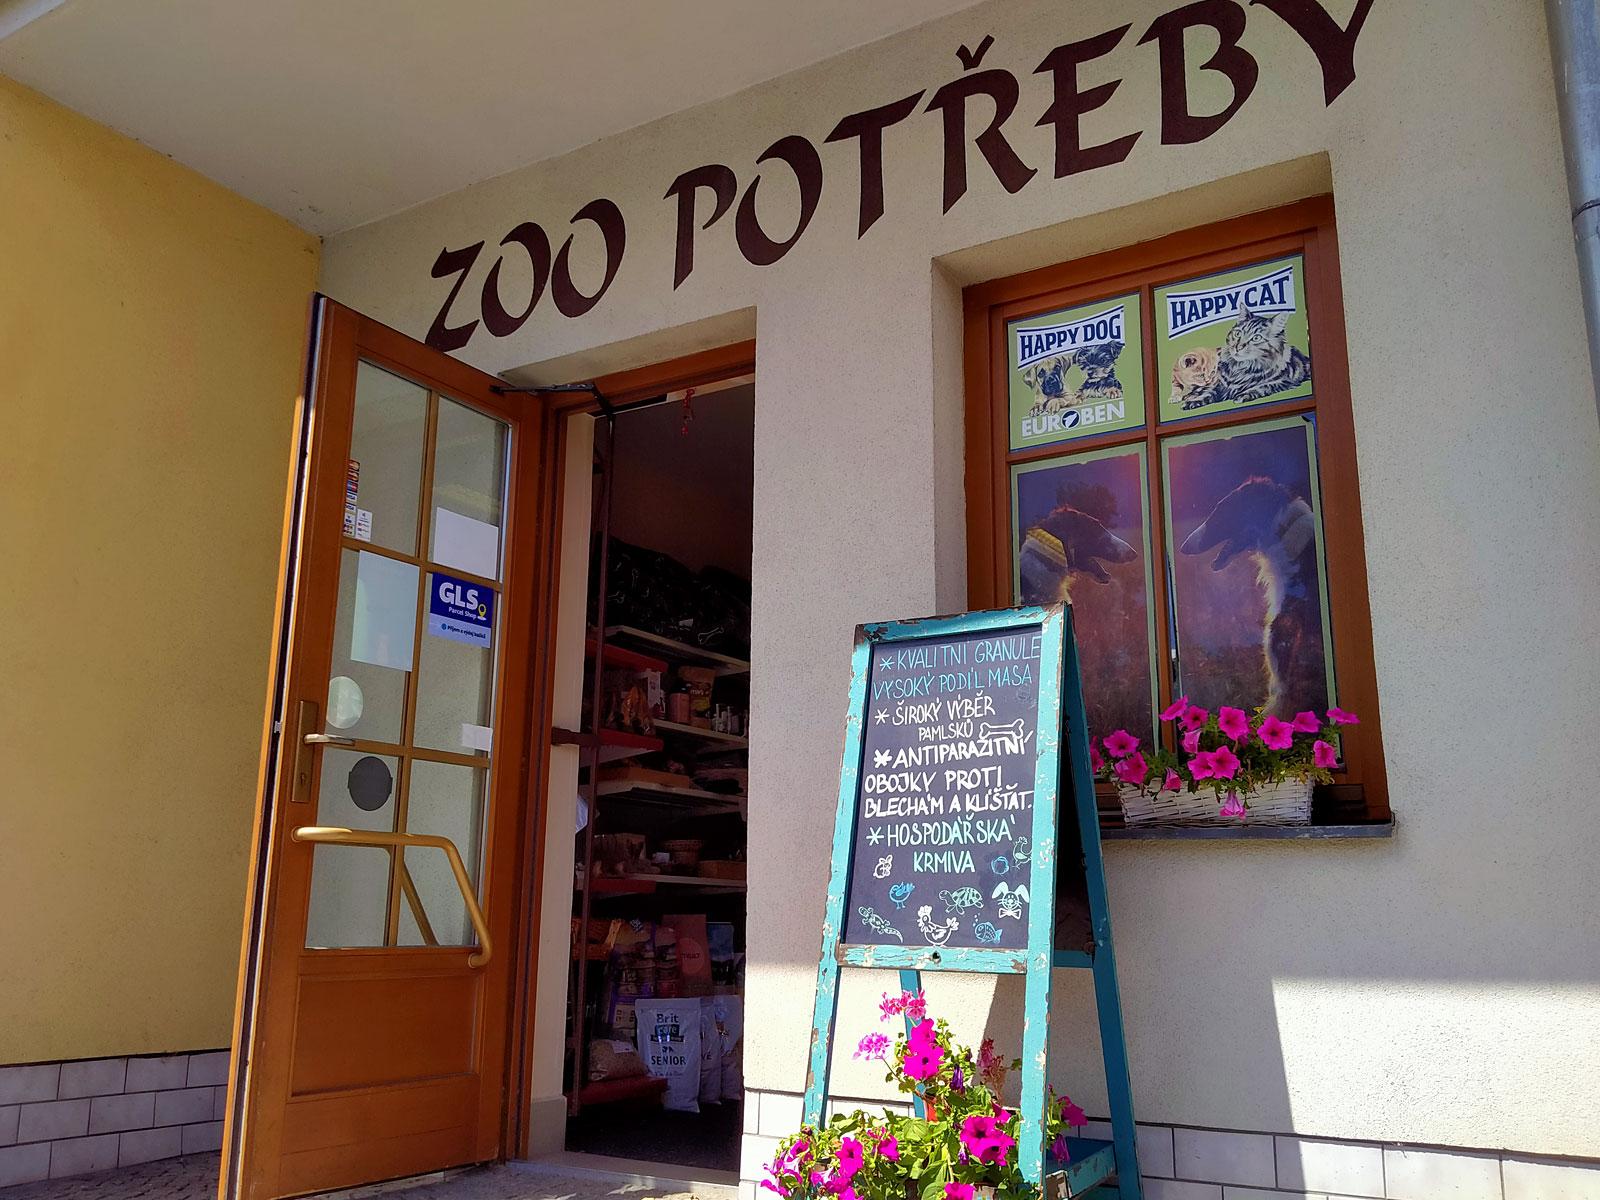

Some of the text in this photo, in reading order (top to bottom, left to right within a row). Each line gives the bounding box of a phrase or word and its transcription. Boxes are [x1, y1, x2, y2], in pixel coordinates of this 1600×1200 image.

[424, 0, 1375, 352] ZOO POTŘEBY
[1171, 275, 1290, 330] HAPPY CAT
[1020, 315, 1122, 361] HAPPY DOG
[439, 582, 479, 610] GLS
[975, 636, 1041, 663] GRANULE
[873, 664, 1032, 700] VYSOKÝ PODÍL MASA
[892, 690, 995, 726] ŠIROKÝ VÝBĚR
[918, 718, 974, 742] PAMLSKŮ
[864, 765, 1001, 793] OBOJKY PROTI
[864, 793, 944, 818] BLECHÁM
[949, 794, 961, 813] A
[913, 850, 976, 874] KRMIVA
[656, 1012, 679, 1023] Brit
[651, 1055, 687, 1066] SENIOR
